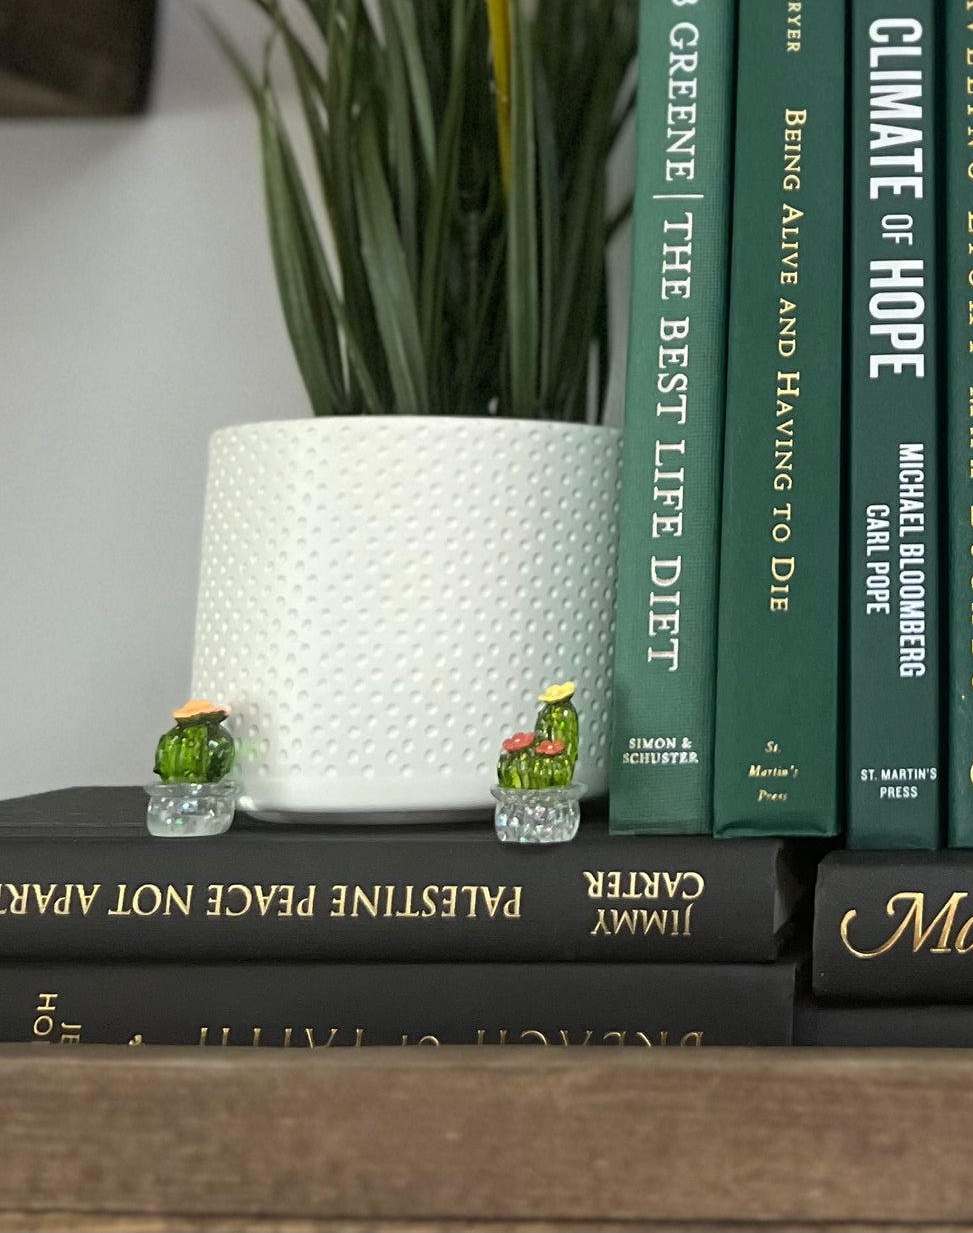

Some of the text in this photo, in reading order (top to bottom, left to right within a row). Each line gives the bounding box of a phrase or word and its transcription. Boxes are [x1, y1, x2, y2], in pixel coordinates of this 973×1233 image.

[666, 22, 699, 181] GREENE
[868, 18, 925, 379] CLIMATE OF HOPE
[647, 212, 693, 672] THE BEST LIFE DIET
[866, 504, 890, 615] CARL POPE
[899, 443, 926, 677] MICHAEL BLOOMBERG
[622, 751, 699, 765] SCHUSTER
[629, 737, 692, 750] SIMON &
[748, 764, 799, 779] Martin's
[860, 767, 937, 781] ST. MARTIN'S
[880, 786, 918, 799] PRESS
[108, 883, 194, 916] NOT
[206, 884, 316, 917] PEACE
[330, 884, 524, 918] PALESTINE
[583, 870, 705, 899] CARTER
[590, 903, 694, 936] JIMMY
